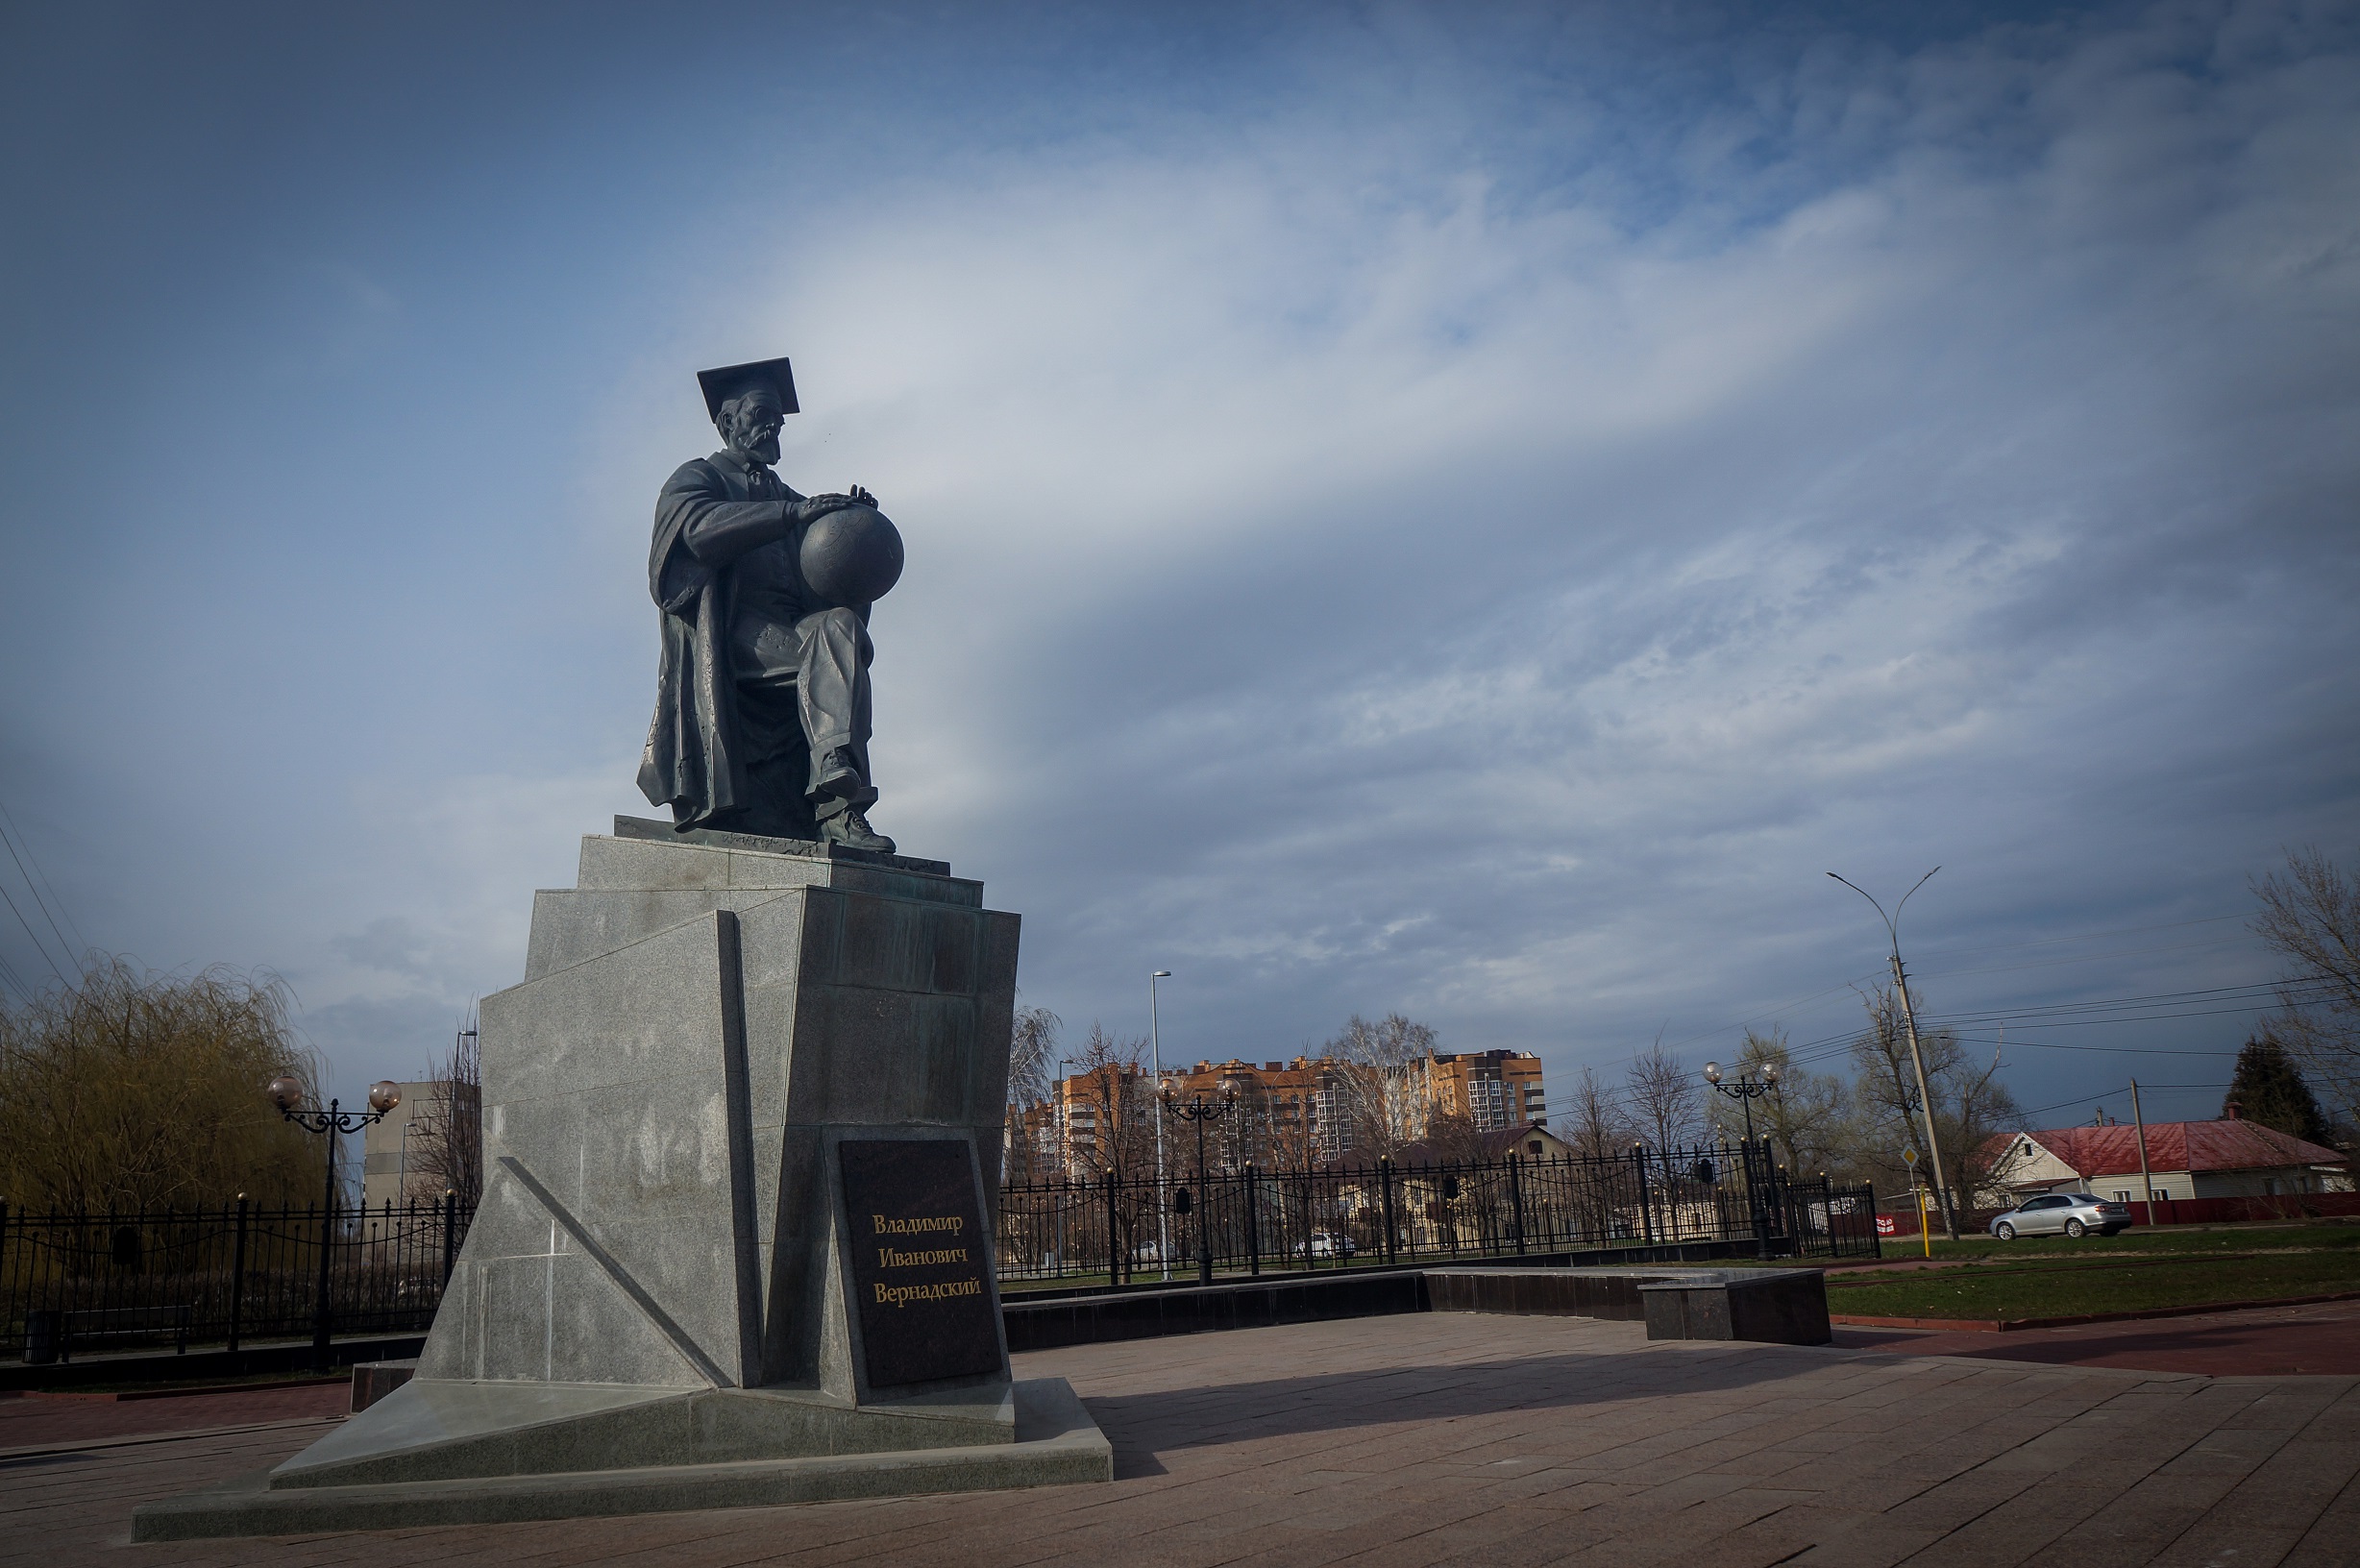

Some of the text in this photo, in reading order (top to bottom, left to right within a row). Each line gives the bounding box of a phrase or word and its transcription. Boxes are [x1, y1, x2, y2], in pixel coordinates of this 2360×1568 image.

[873, 1214, 964, 1237] Владимир
[878, 1248, 969, 1268] Иванович
[873, 1277, 982, 1309] Вернадский
